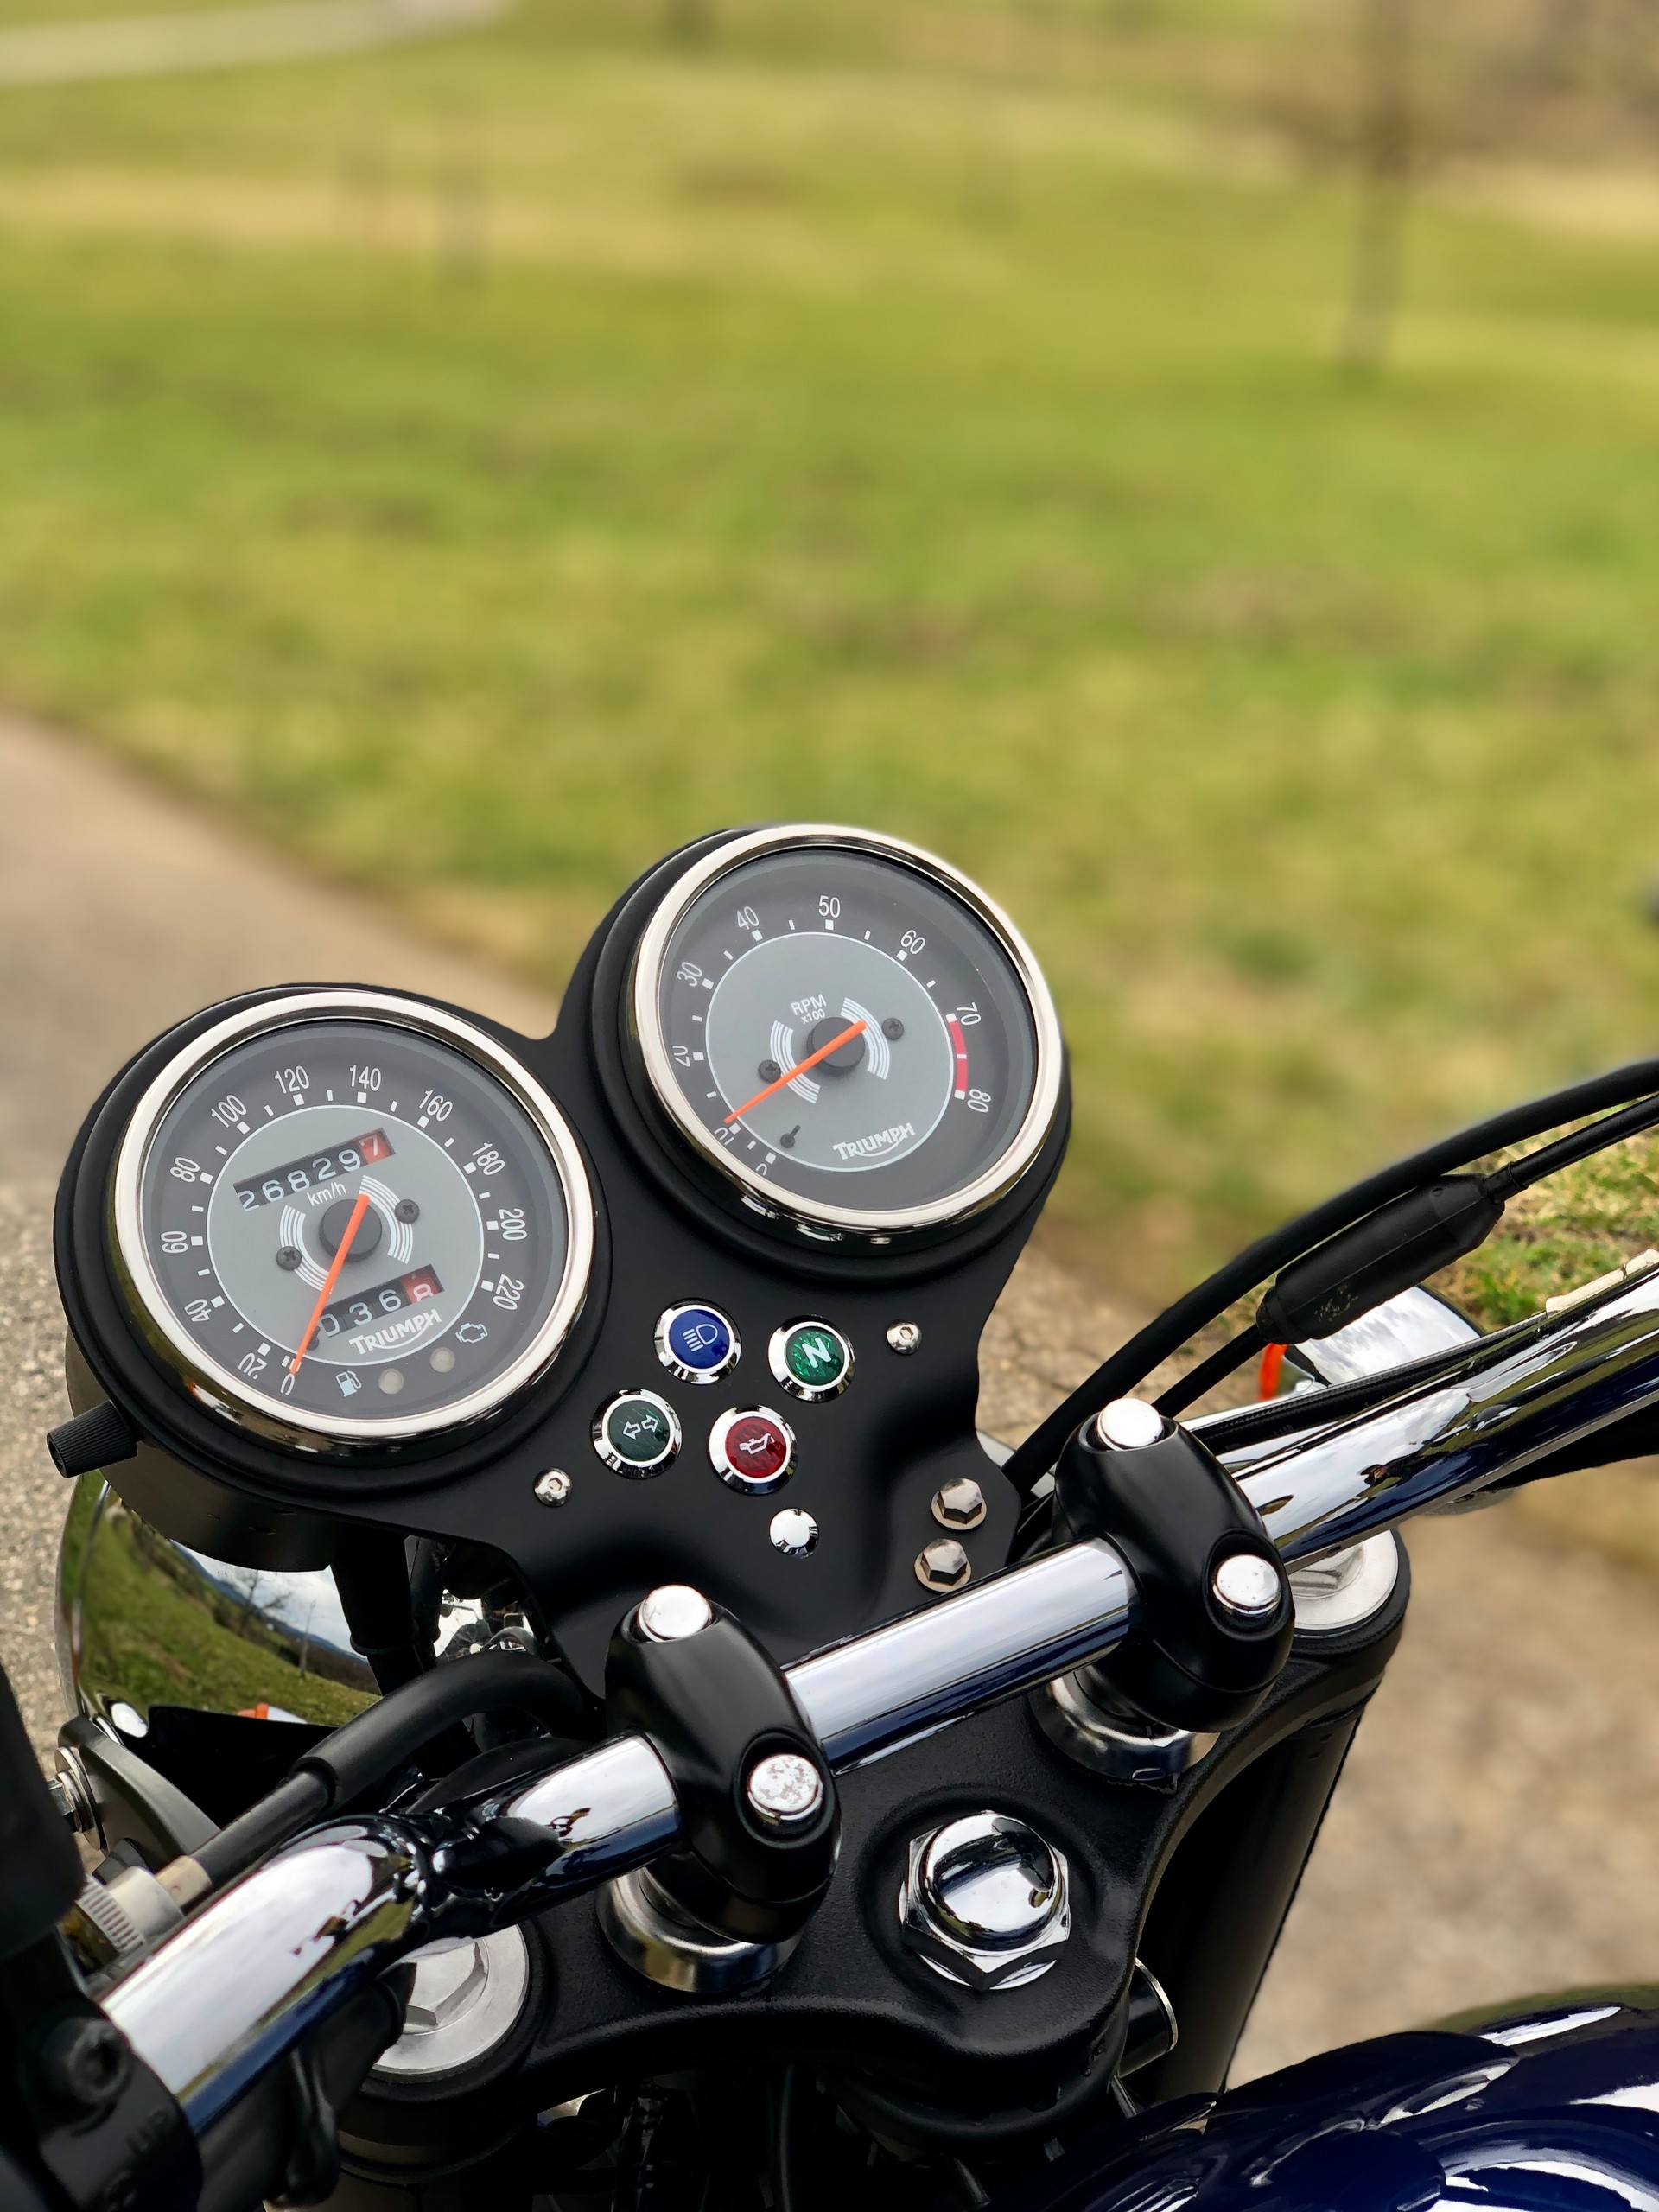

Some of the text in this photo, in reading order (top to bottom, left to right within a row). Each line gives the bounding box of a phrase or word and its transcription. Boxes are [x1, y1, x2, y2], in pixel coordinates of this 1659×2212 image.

[737, 906, 759, 929] 40
[819, 896, 841, 918] 50
[901, 930, 925, 954] 60
[677, 962, 702, 987] 30
[791, 994, 827, 1015] RPM
[801, 1008, 826, 1024] x100
[957, 1002, 982, 1026] 70
[275, 1066, 310, 1093] 120
[350, 1065, 382, 1090] 140
[211, 1095, 246, 1128] 100
[419, 1090, 452, 1122] 160
[968, 1089, 992, 1114] 80
[833, 1122, 916, 1161] TRIUMPH
[170, 1157, 200, 1183] 80
[471, 1142, 505, 1176] 180
[306, 1181, 347, 1206] km/h
[499, 1208, 528, 1241] 200
[162, 1230, 188, 1254] 60
[493, 1274, 524, 1311] 220
[184, 1299, 212, 1322] 40
[349, 1309, 442, 1354] TRIUMPH
[801, 1338, 832, 1368] N
[238, 1352, 268, 1380] 20
[280, 1373, 295, 1395] 0
